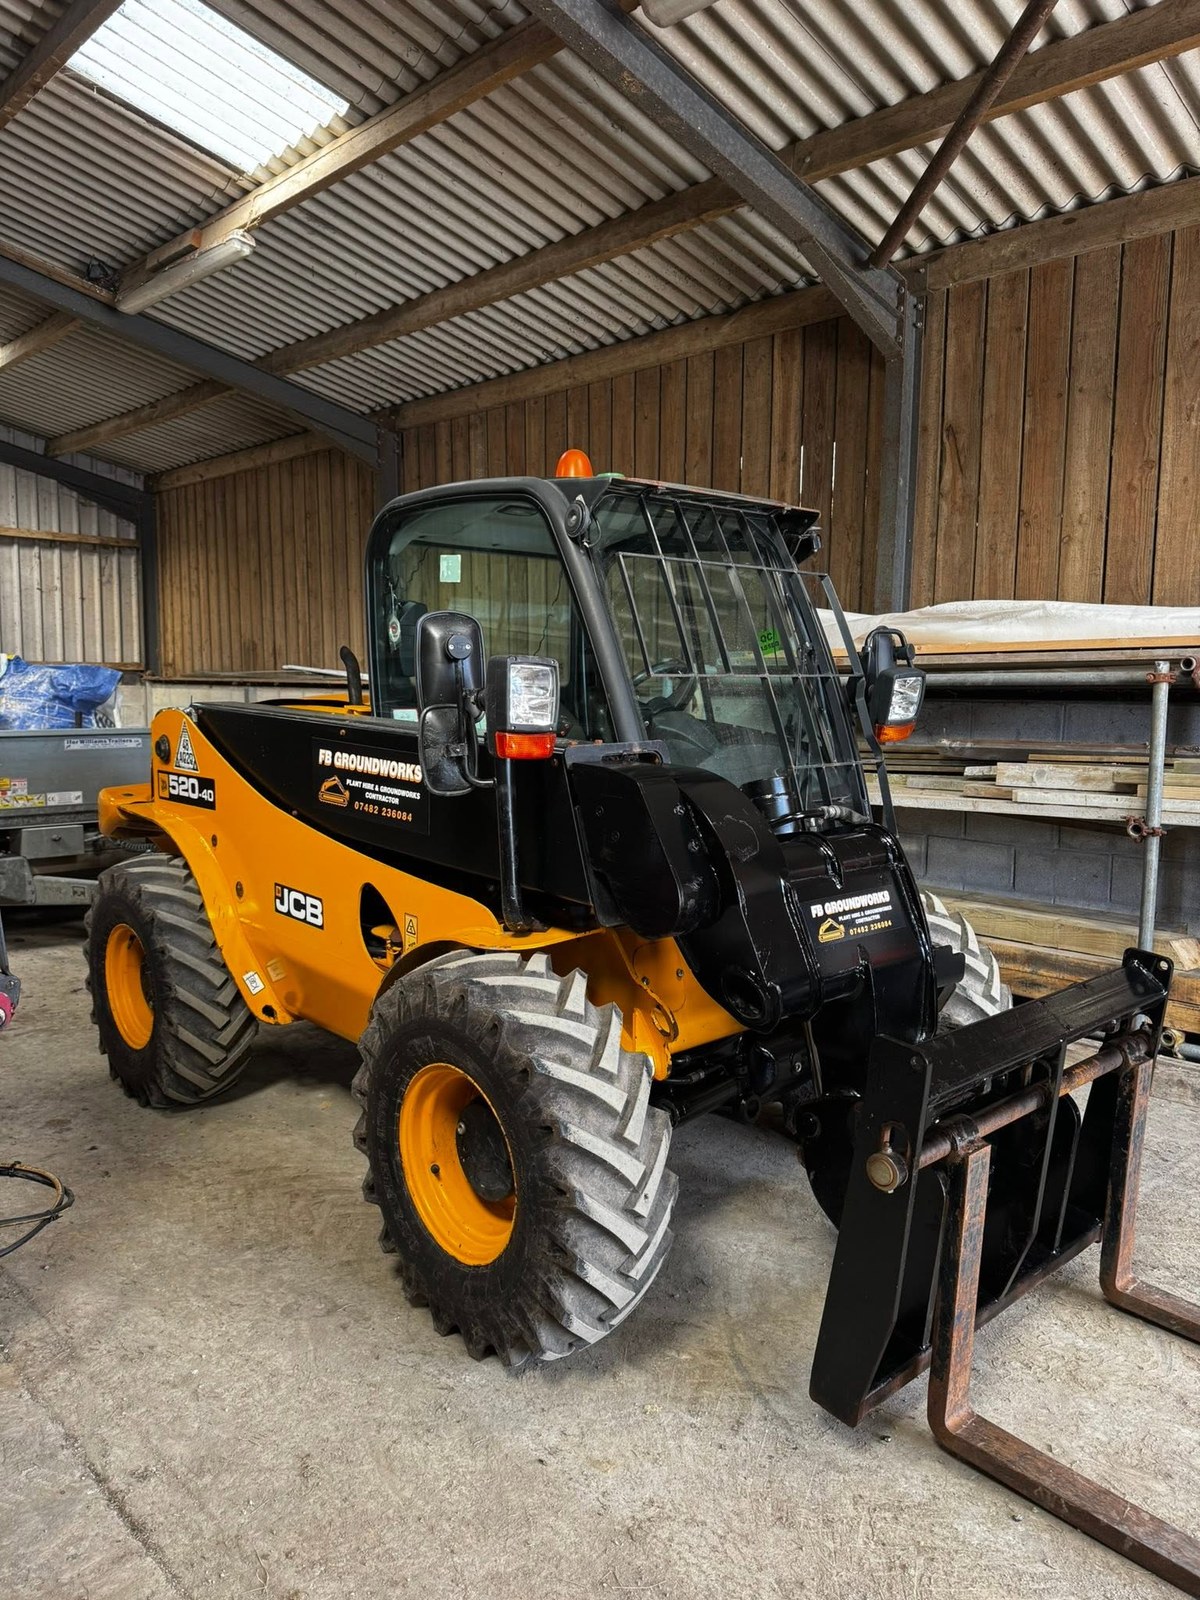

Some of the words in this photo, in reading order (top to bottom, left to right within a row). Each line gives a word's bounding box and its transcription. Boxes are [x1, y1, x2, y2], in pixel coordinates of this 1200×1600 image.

[760, 632, 773, 642] QC
[319, 749, 333, 767] FB
[334, 751, 422, 784] GROUNDWORKS
[346, 778, 362, 788] PLANT
[362, 781, 375, 791] HIRE
[380, 785, 421, 800] GROUNDWORKS
[365, 792, 400, 805] CONTRACTOR
[354, 801, 379, 815] 07482
[381, 808, 412, 822] 236084
[275, 887, 324, 927] JCB
[810, 904, 824, 918] FB
[824, 890, 890, 915] GROUNDWORKS
